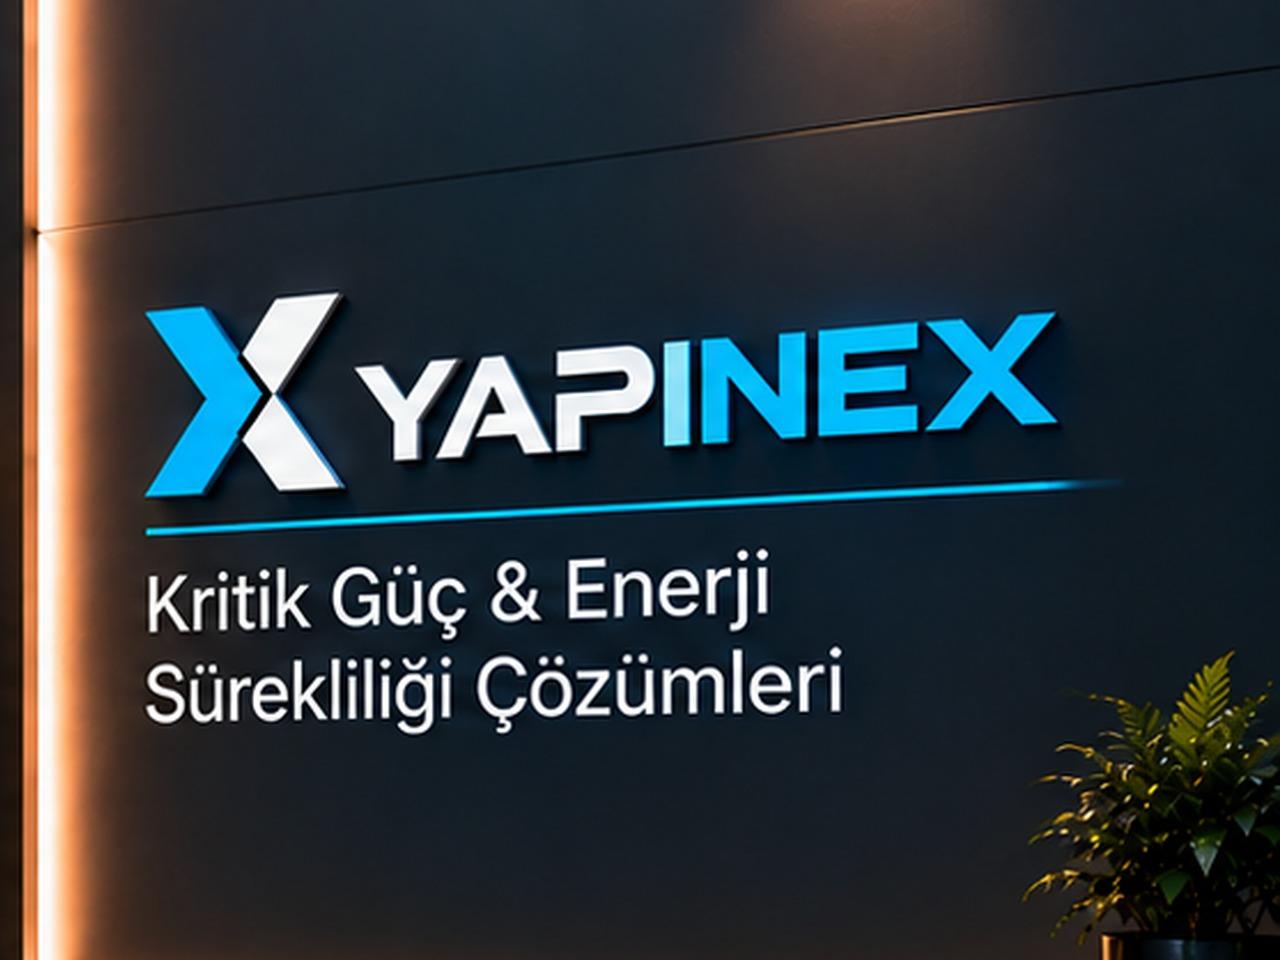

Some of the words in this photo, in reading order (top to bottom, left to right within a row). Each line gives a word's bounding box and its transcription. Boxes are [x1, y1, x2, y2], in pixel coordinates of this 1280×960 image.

[356, 312, 1057, 462] YAPINEX
[148, 567, 311, 633] Kritik
[332, 564, 467, 640] Güç
[490, 560, 541, 622] &
[568, 548, 769, 632] Enerji
[146, 656, 452, 735] Sürekliliği
[477, 646, 842, 734] Çözümleri
